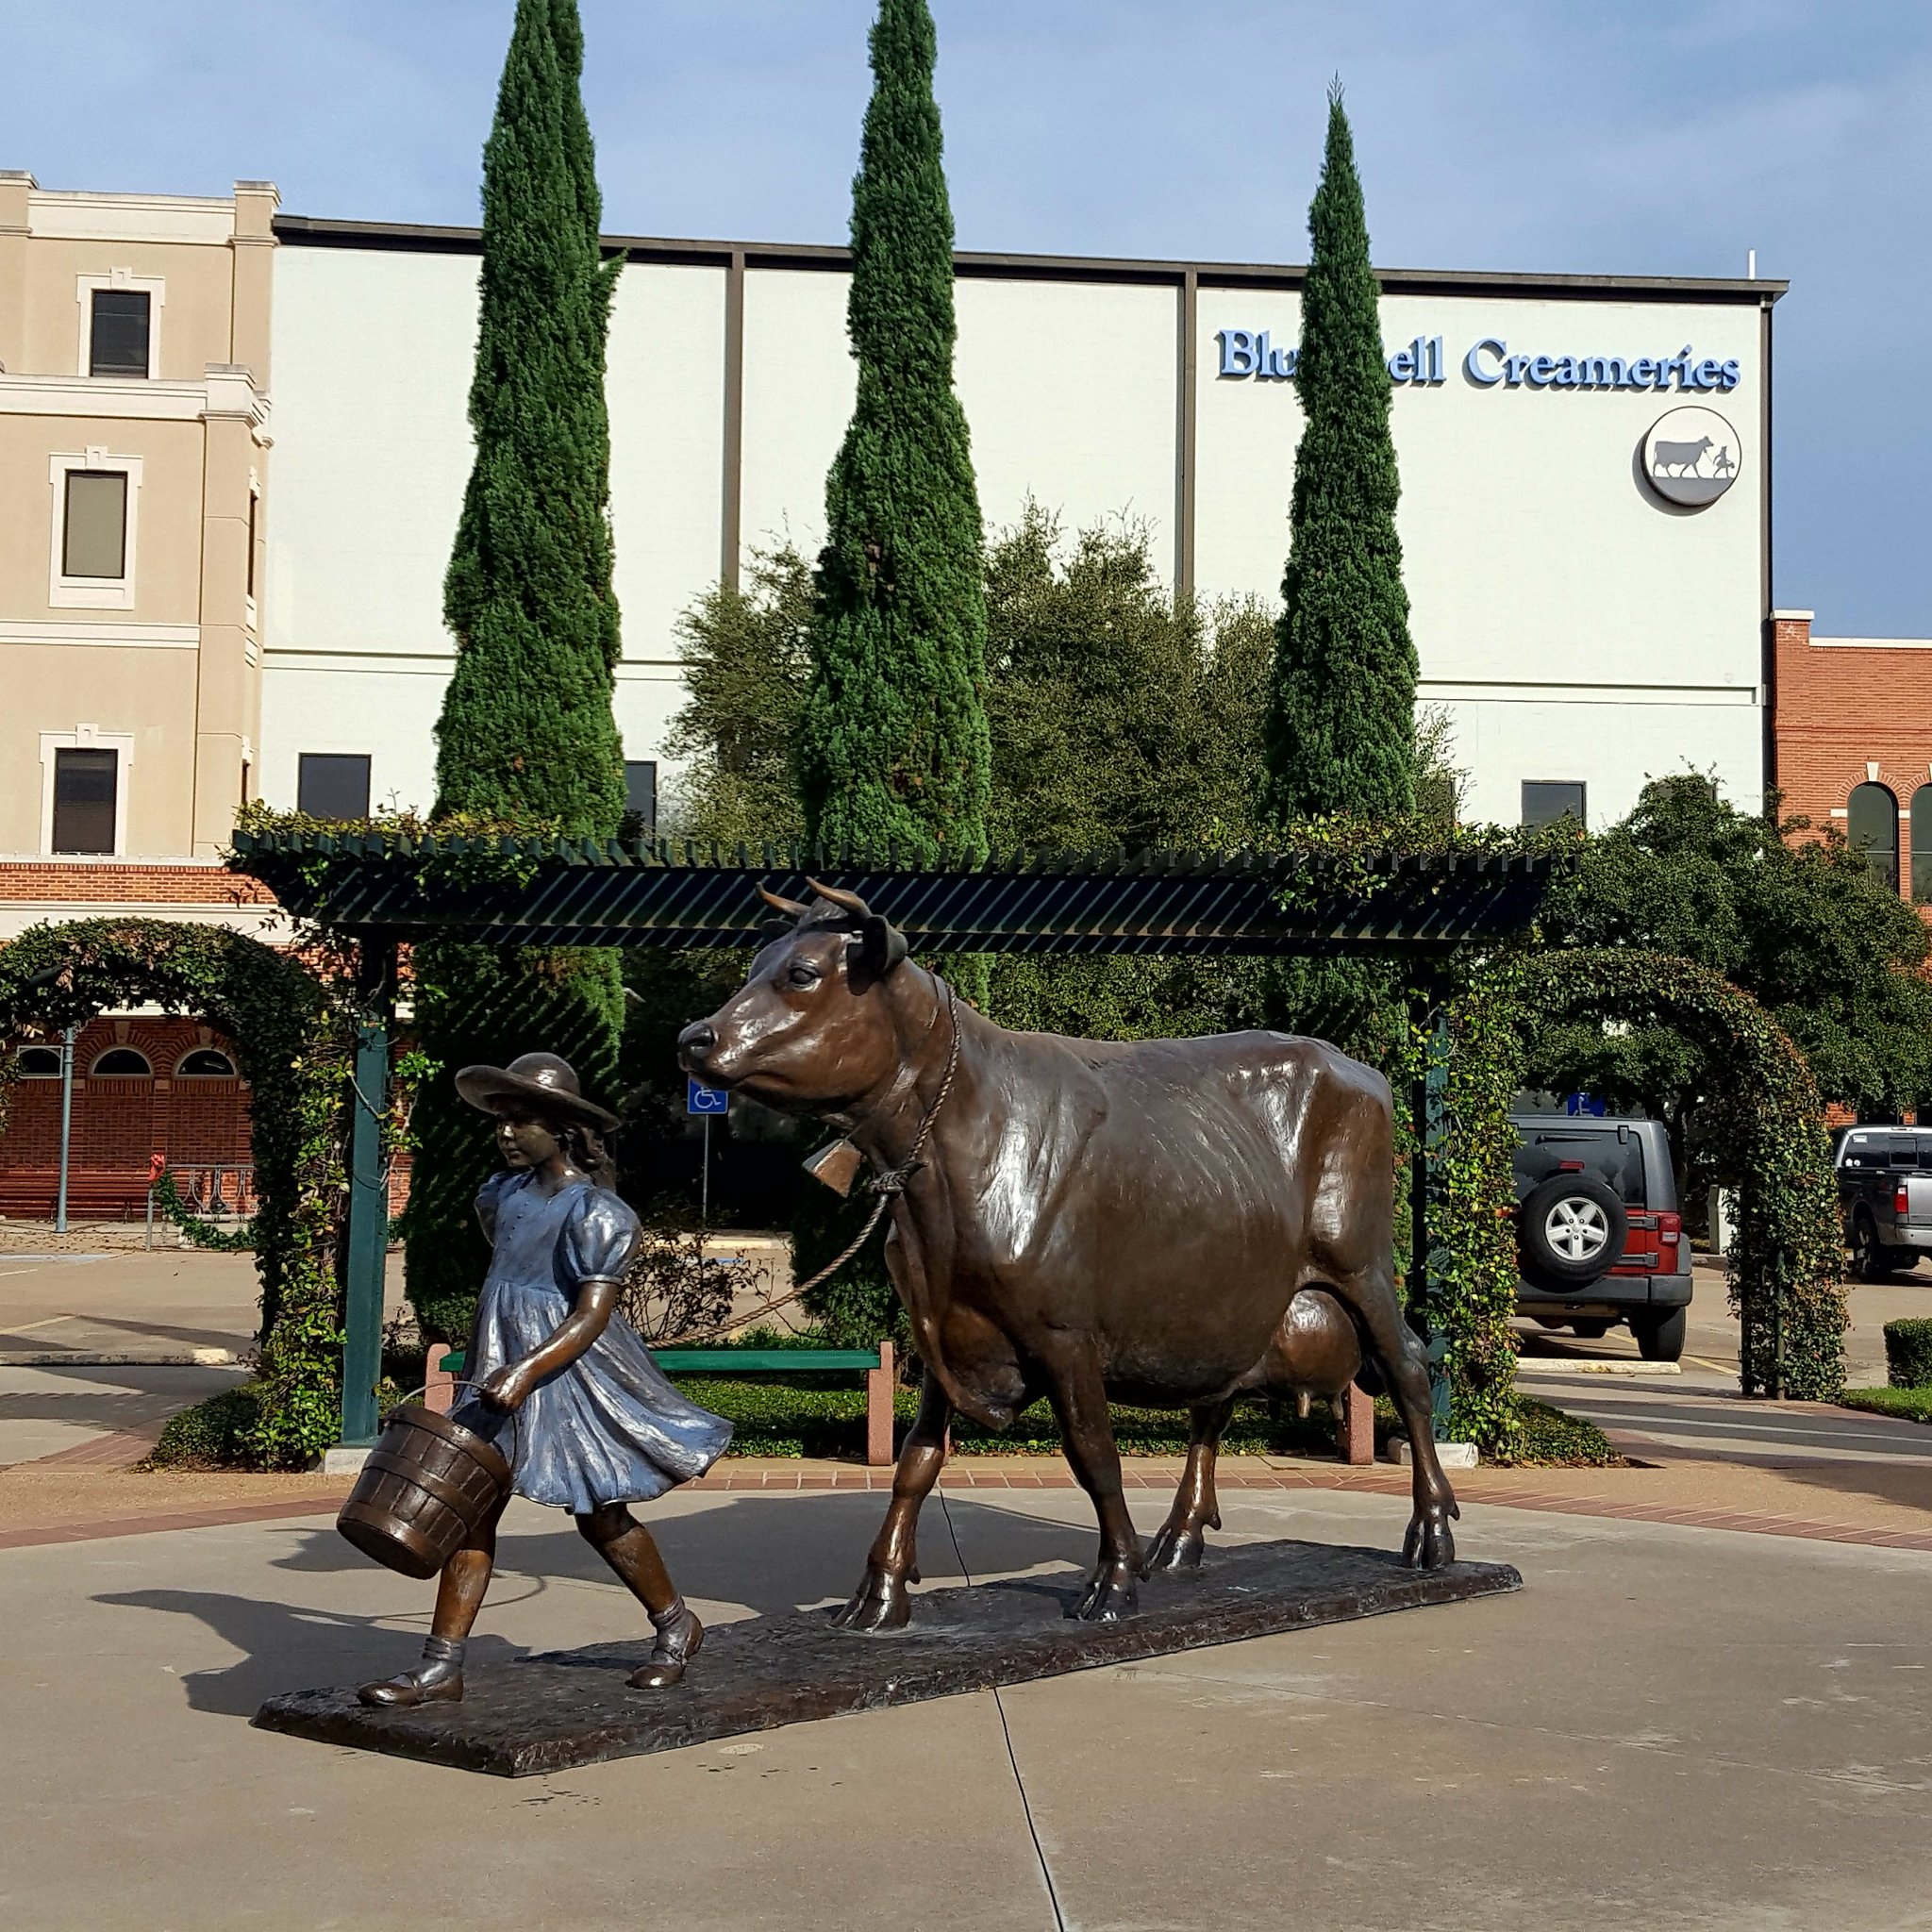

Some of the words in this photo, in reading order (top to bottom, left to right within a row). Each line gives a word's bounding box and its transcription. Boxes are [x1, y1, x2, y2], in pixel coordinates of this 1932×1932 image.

[1218, 329, 1299, 377] Blu
[1383, 335, 1447, 381] ell
[1467, 337, 1740, 389] Creameries
